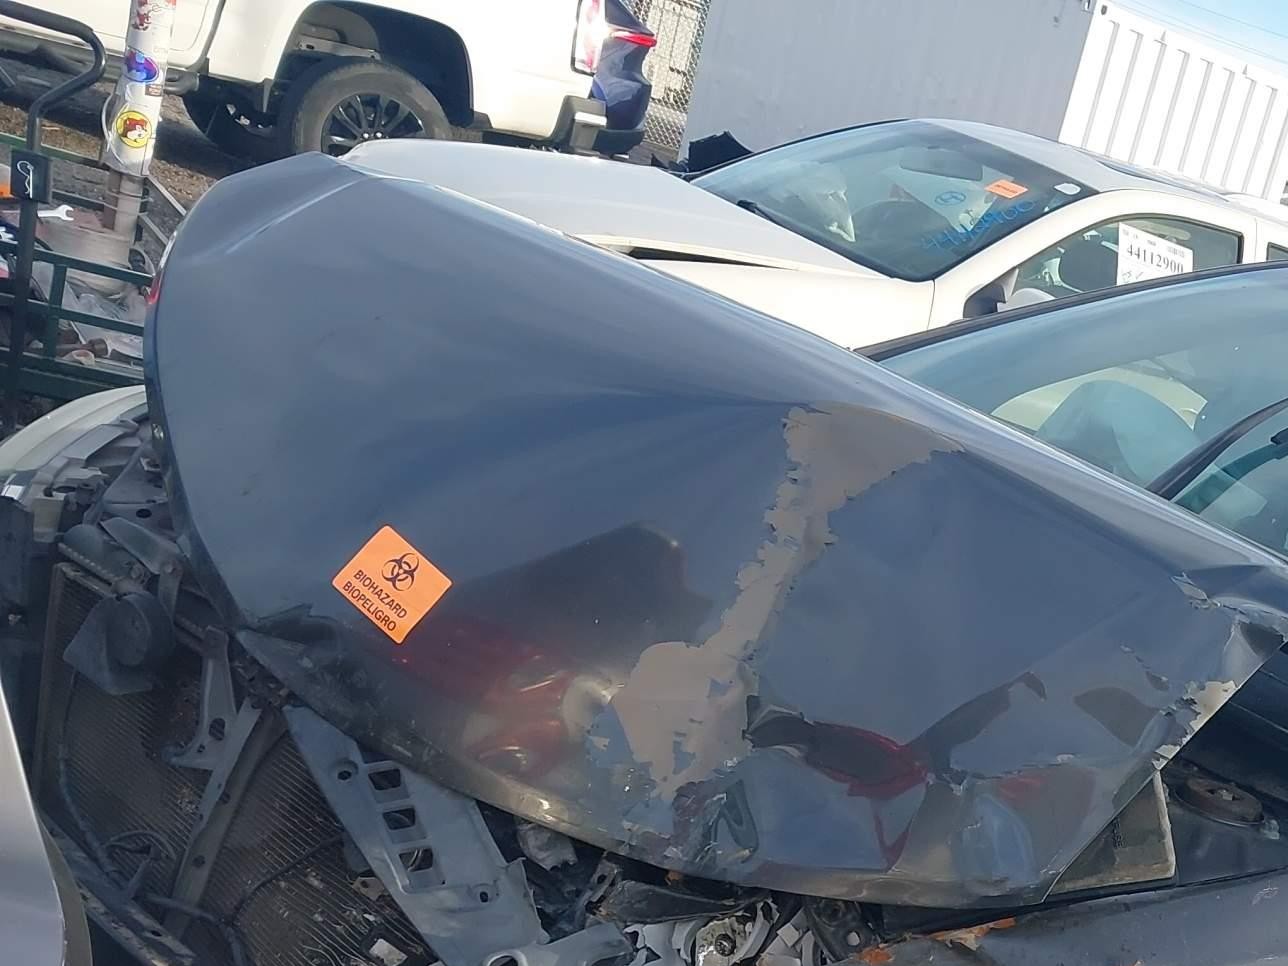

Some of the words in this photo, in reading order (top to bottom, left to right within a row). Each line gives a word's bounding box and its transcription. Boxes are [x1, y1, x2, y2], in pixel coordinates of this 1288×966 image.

[1126, 243, 1184, 274] 44112900
[342, 580, 397, 632] BIOPELIGRO
[353, 569, 408, 619] BIOHAZARD
